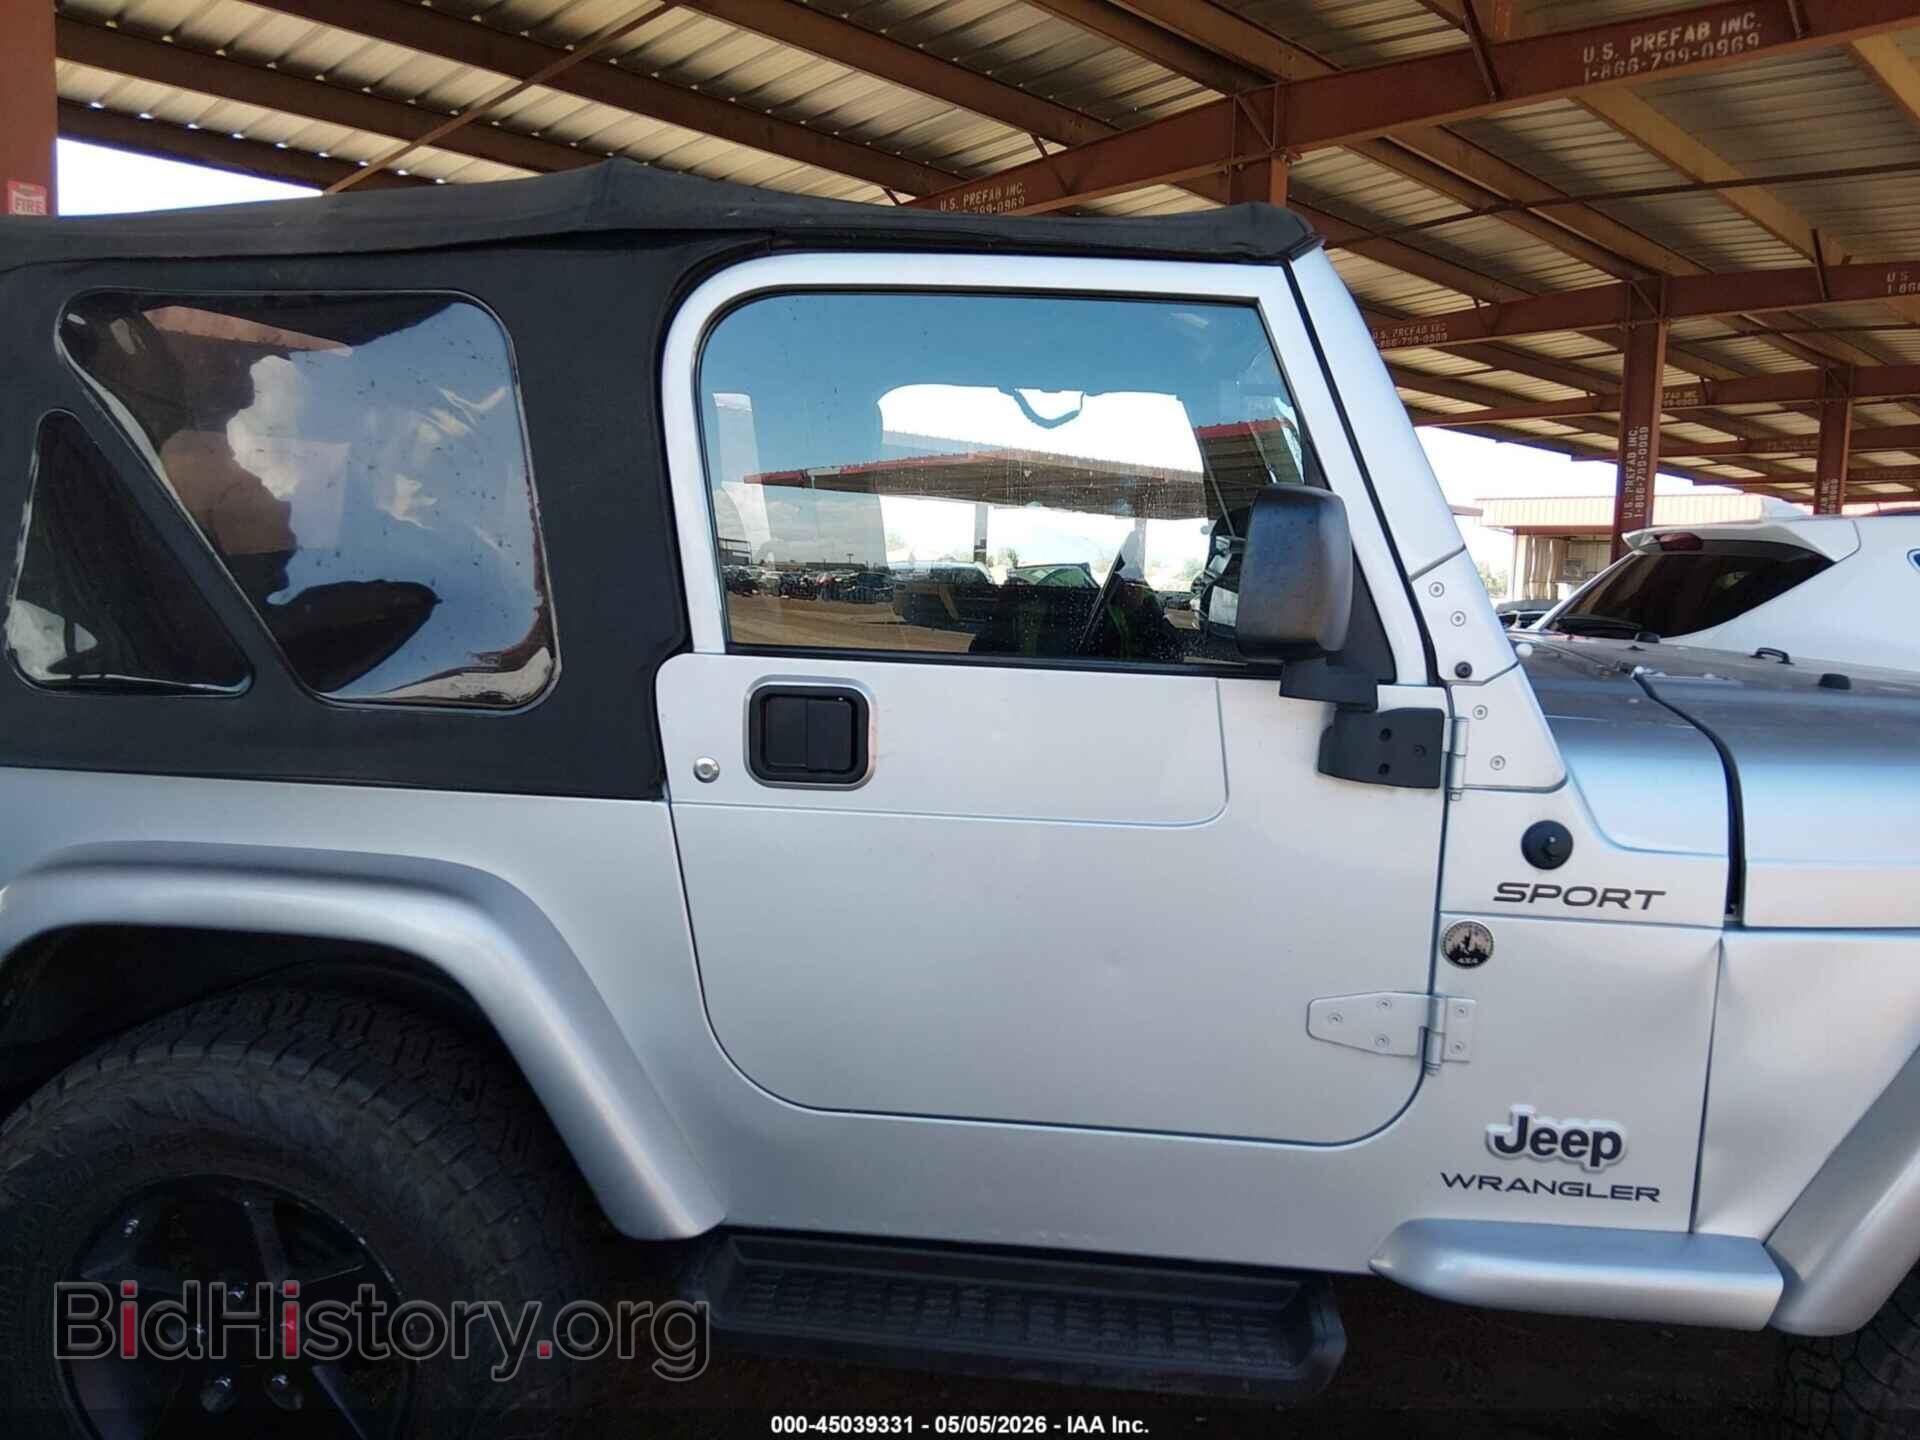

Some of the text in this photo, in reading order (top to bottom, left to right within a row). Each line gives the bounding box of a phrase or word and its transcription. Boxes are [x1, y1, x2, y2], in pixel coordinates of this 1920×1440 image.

[1583, 12, 1762, 64] U.S. PREFAB INC.
[963, 186, 1001, 208] PREFAB
[1493, 882, 1667, 910] SPORT
[1488, 1106, 1625, 1170] Jeep
[1440, 1172, 1661, 1202] WRANGLER
